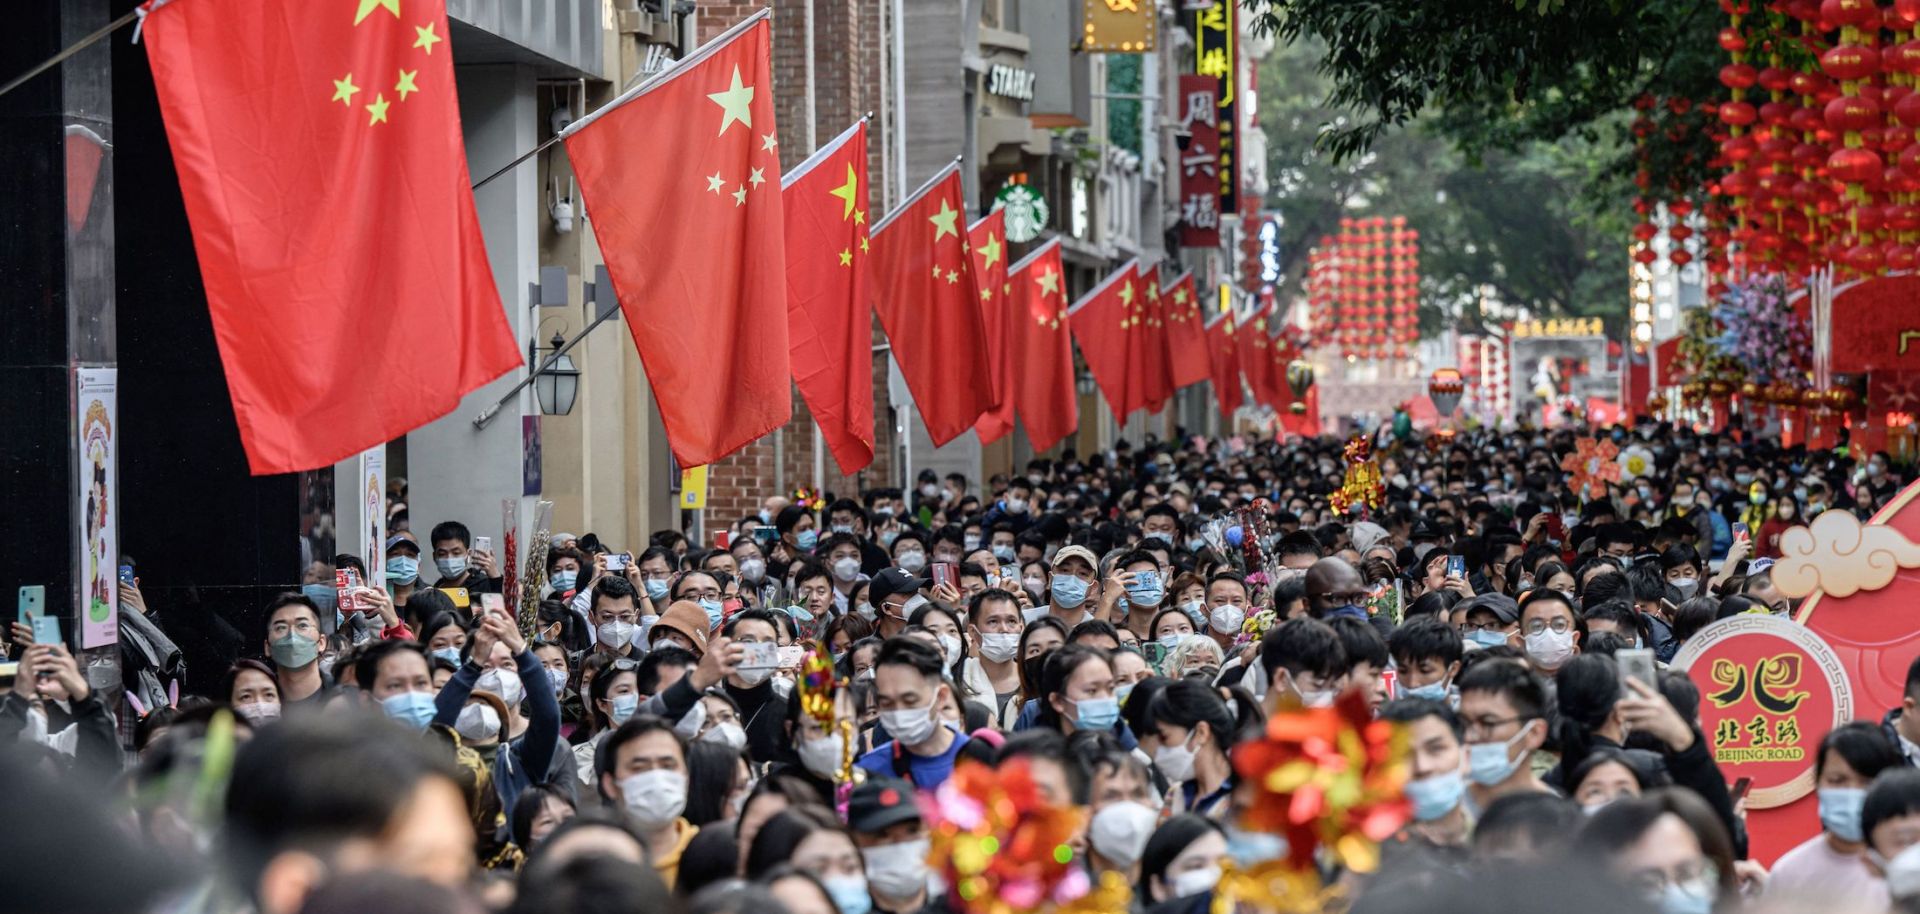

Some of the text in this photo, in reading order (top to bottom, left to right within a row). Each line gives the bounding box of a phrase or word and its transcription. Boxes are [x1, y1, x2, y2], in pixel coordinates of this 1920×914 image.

[1182, 90, 1216, 230] 周六福
[1715, 715, 1800, 746] 北京路
[1716, 747, 1804, 763] BEIJING ROAD
